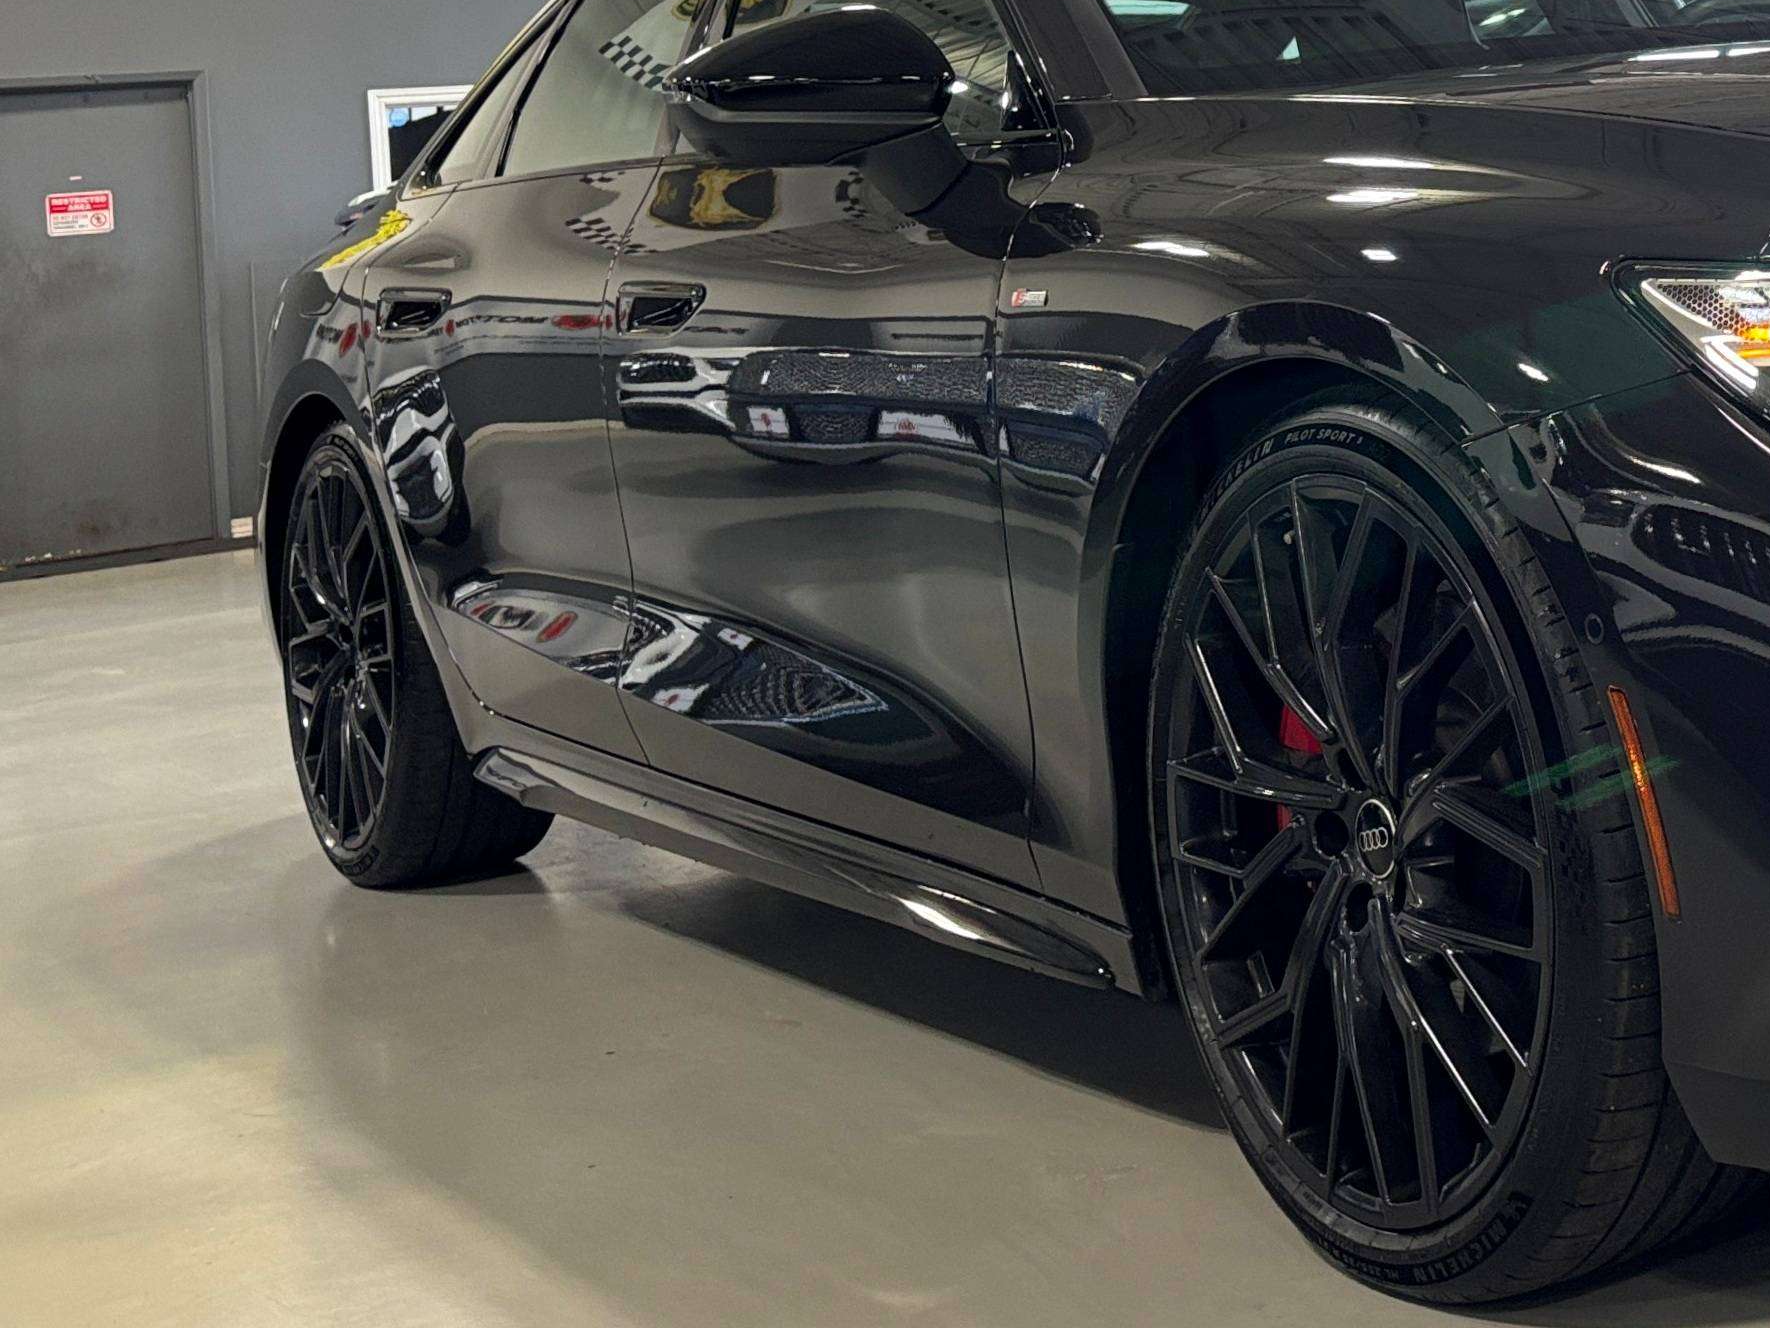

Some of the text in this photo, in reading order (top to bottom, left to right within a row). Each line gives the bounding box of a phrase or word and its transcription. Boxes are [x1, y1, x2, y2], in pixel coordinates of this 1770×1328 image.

[1284, 428, 1317, 445] PILOT
[1316, 428, 1357, 444] SPORT
[1413, 1219, 1507, 1283] MICHELIN
